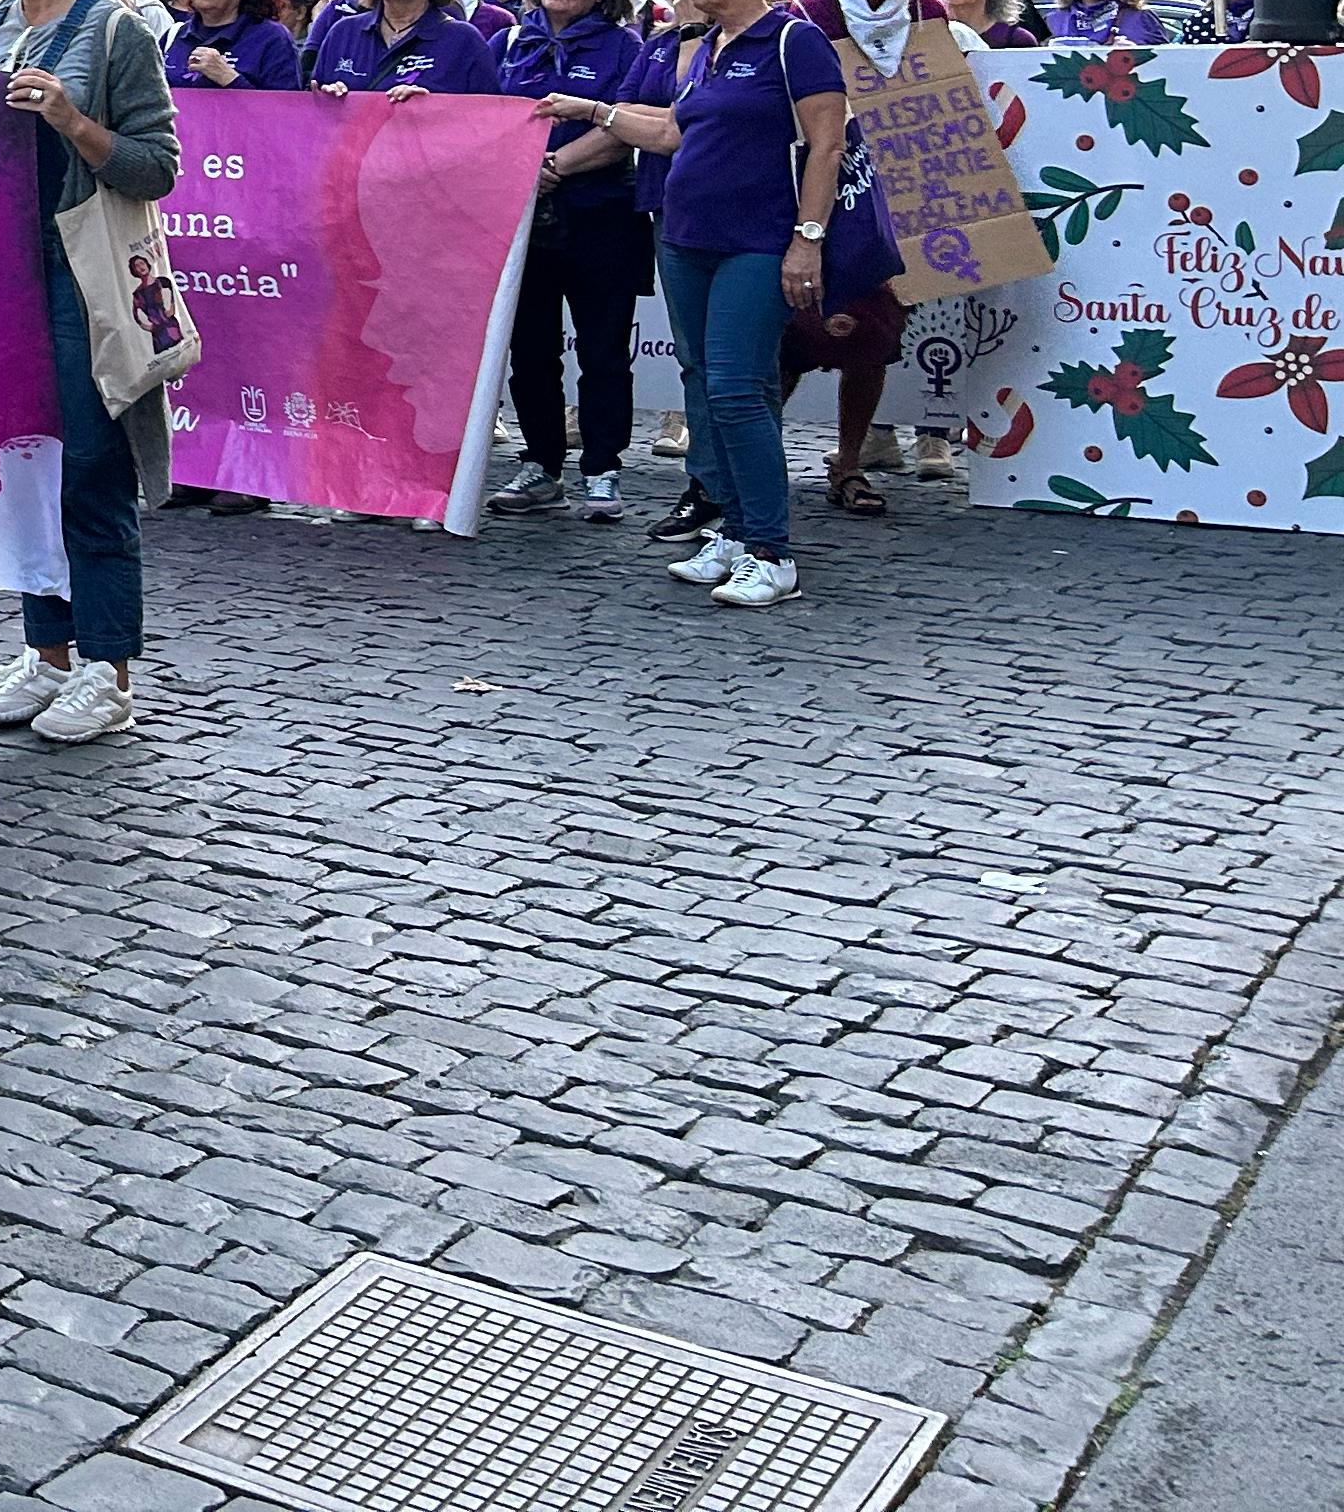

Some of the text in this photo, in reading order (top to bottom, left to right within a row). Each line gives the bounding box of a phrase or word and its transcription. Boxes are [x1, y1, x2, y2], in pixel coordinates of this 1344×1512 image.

[203, 154, 244, 180] es
[173, 263, 298, 298] encia"
[1154, 231, 1247, 293] Feliz
[1054, 282, 1341, 348] Santa Cruz de
[619, 1421, 739, 1512] SANEAMIEN
